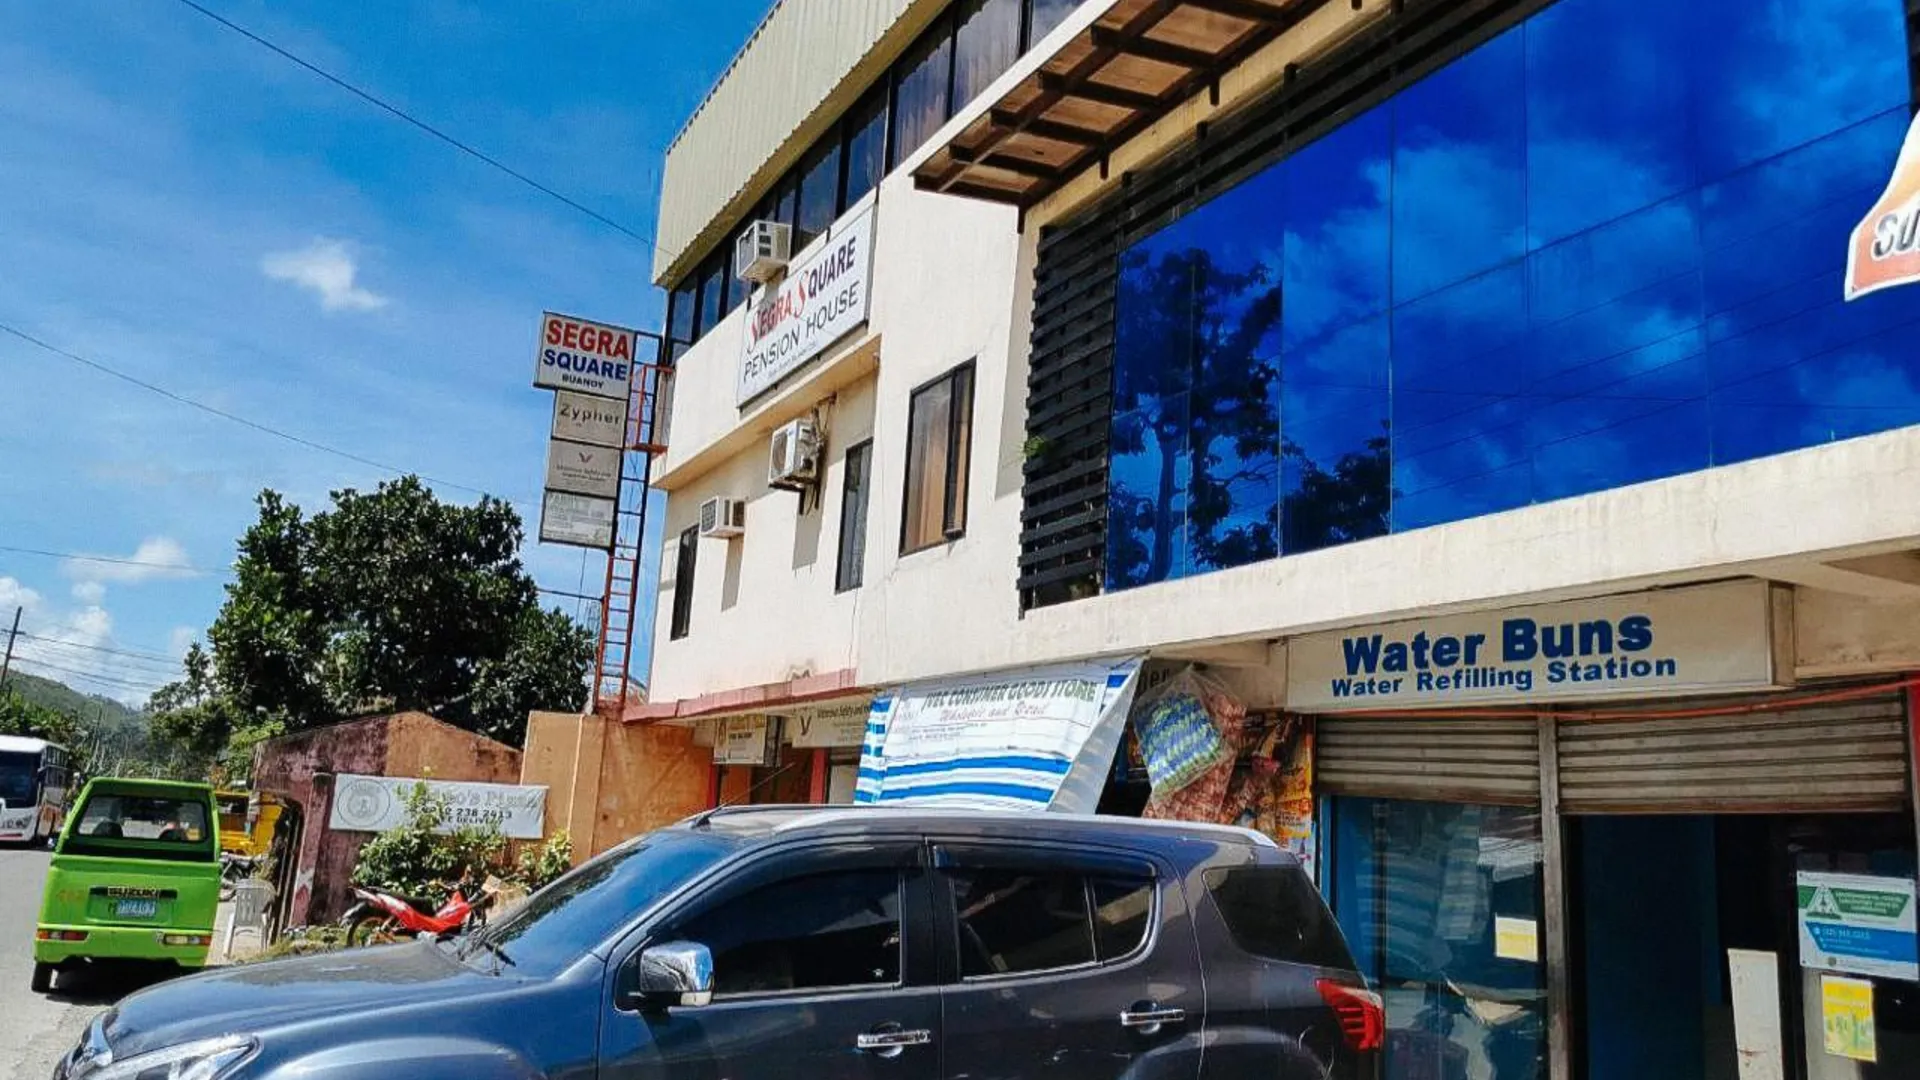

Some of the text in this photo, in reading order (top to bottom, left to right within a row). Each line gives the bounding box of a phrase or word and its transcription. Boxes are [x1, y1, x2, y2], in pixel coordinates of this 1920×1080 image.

[747, 236, 857, 354] SEGRA SQUARE
[546, 319, 630, 361] SEGRA
[743, 323, 801, 383] PENSION
[805, 280, 861, 338] HOUSE
[543, 347, 628, 382] SQUARE
[559, 402, 621, 426] Zypher
[1343, 615, 1654, 676] Water Buns
[1331, 657, 1677, 698] Water Refilling Station
[456, 807, 478, 818] 238
